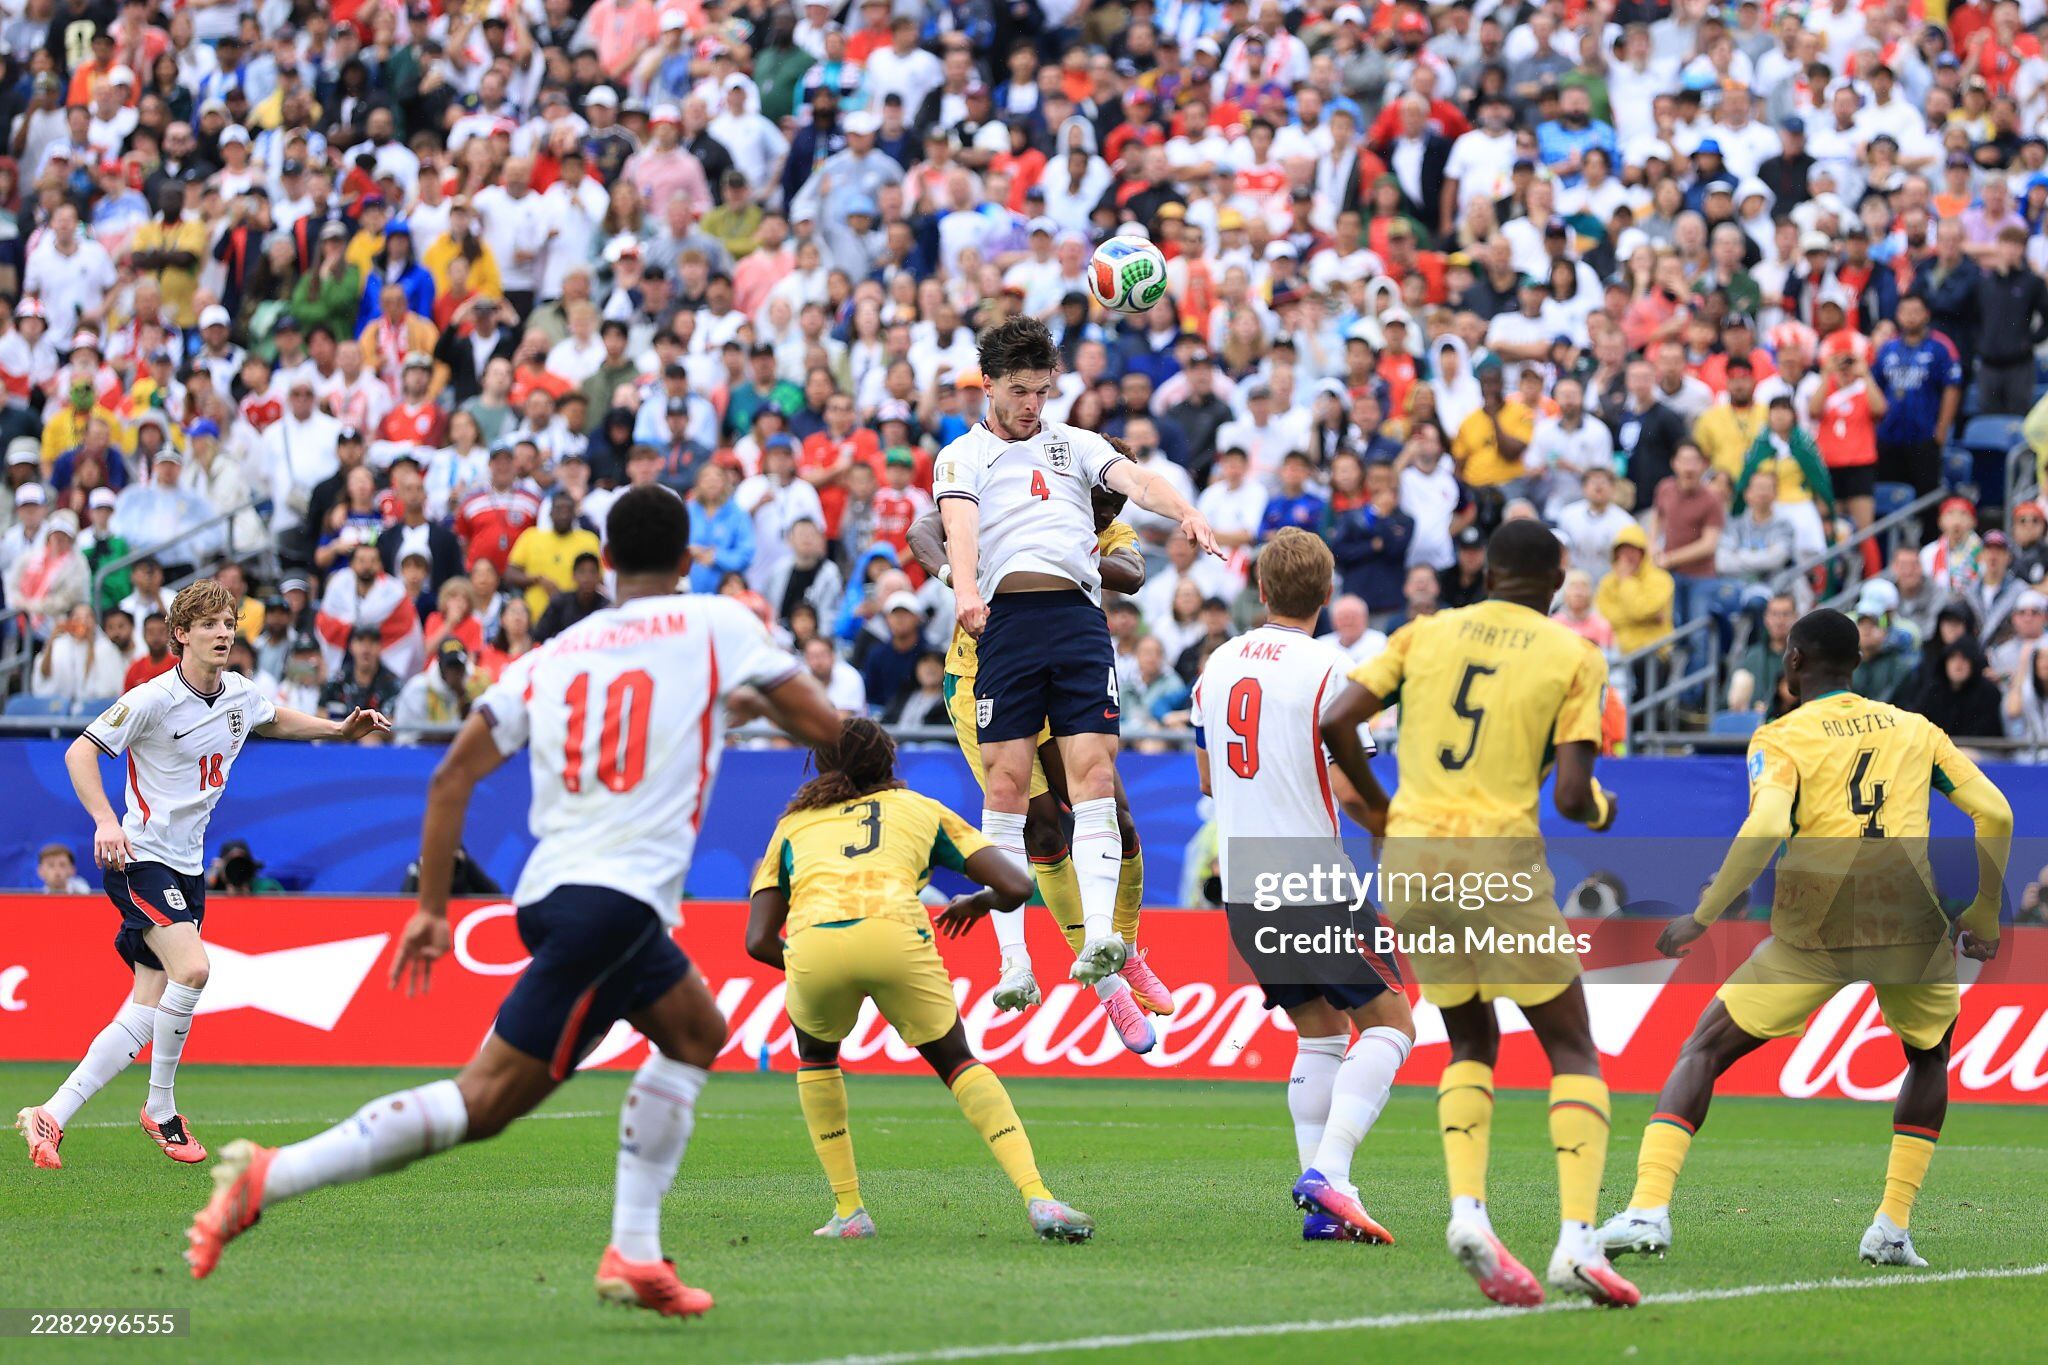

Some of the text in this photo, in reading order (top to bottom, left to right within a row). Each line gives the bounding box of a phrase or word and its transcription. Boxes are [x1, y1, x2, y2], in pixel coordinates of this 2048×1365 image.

[1030, 469, 1051, 501] 4
[1239, 641, 1287, 662] KANE
[1458, 620, 1537, 650] PARTEY
[1106, 666, 1119, 707] 4
[563, 669, 655, 794] 10
[1227, 677, 1262, 779] 9
[1438, 660, 1498, 771] 5
[1822, 713, 1896, 737] ADJETEY
[199, 752, 224, 791] 18
[1846, 747, 1890, 839] 4
[841, 799, 885, 859] 3
